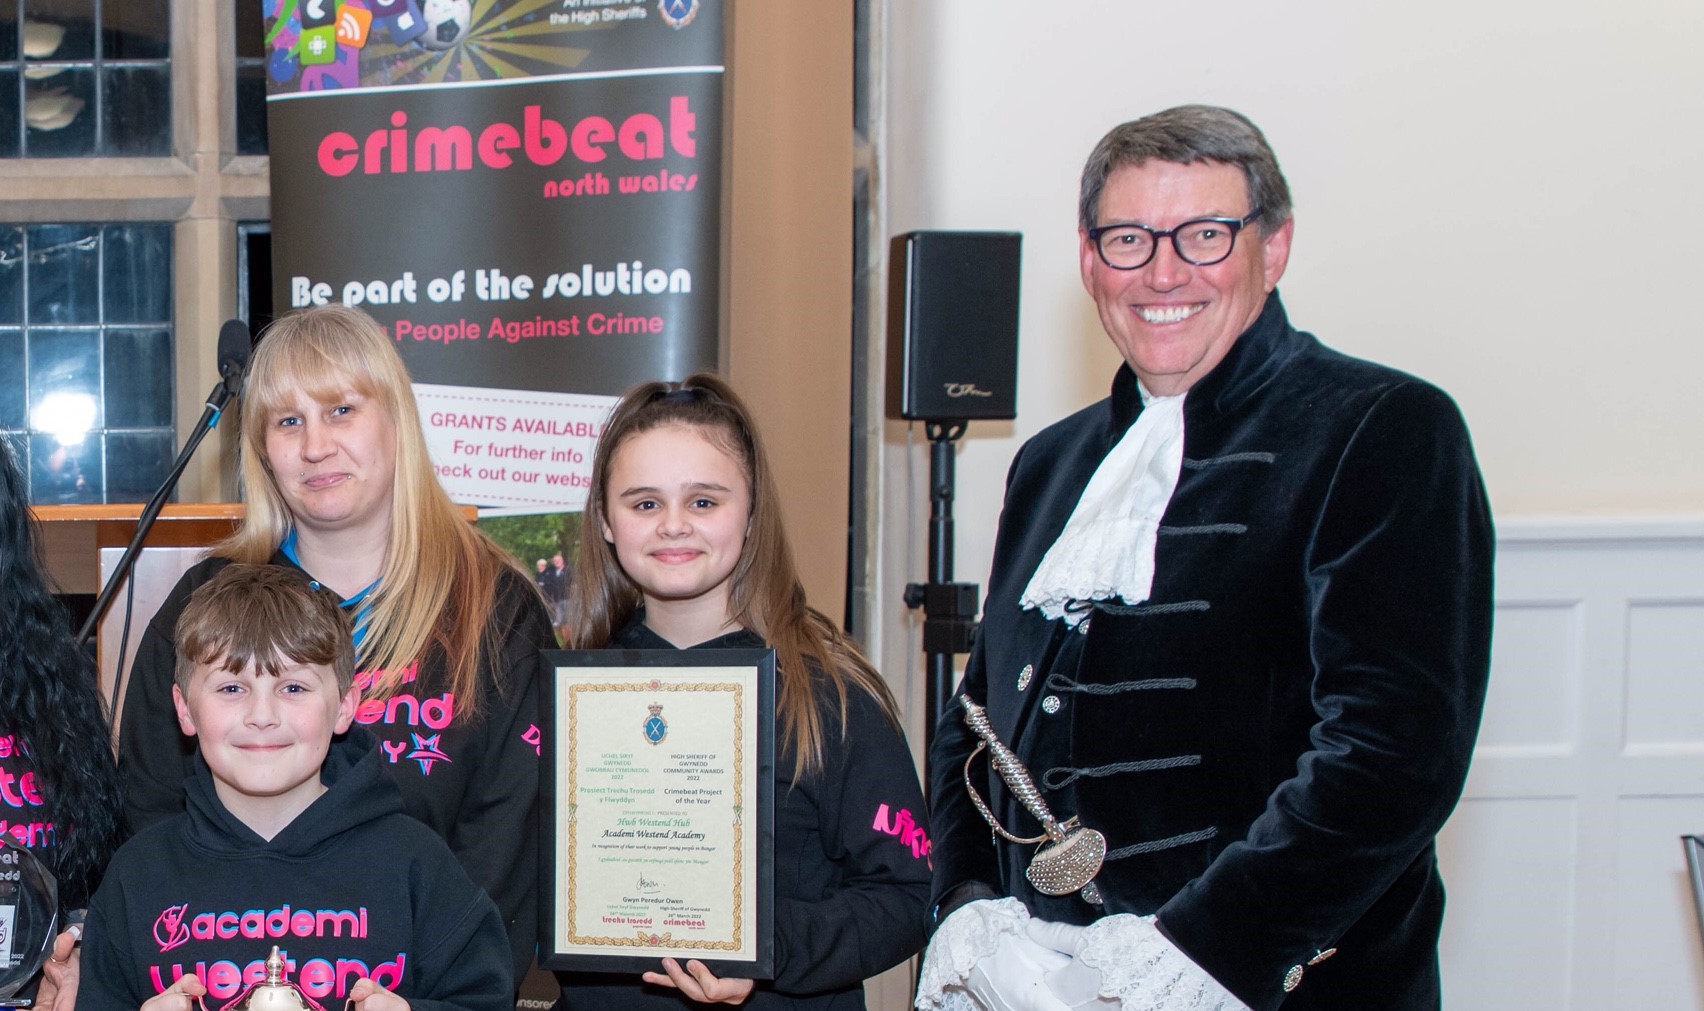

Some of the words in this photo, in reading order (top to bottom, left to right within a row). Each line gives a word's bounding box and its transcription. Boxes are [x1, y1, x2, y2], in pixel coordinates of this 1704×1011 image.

[549, 13, 570, 25] the
[571, 10, 600, 25] High
[601, 6, 647, 22] Sheriffs
[317, 96, 697, 177] crimebeat
[544, 172, 610, 198] north
[619, 168, 698, 194] wales
[291, 276, 333, 307] Be
[343, 271, 417, 308] part
[427, 269, 466, 303] of
[475, 268, 534, 301] the
[542, 260, 691, 299] solution
[396, 318, 481, 345] People
[487, 314, 581, 343] Against
[587, 312, 664, 336] Crime
[430, 412, 507, 432] GRANTS
[452, 440, 483, 456] For
[488, 442, 546, 461] further
[551, 446, 584, 464] info
[478, 467, 507, 481] out
[511, 470, 540, 483] our
[601, 828, 635, 838] Academi
[636, 829, 671, 839] Westend
[670, 830, 706, 841] Academy
[192, 903, 368, 940] academi
[663, 919, 706, 927] crimebeat
